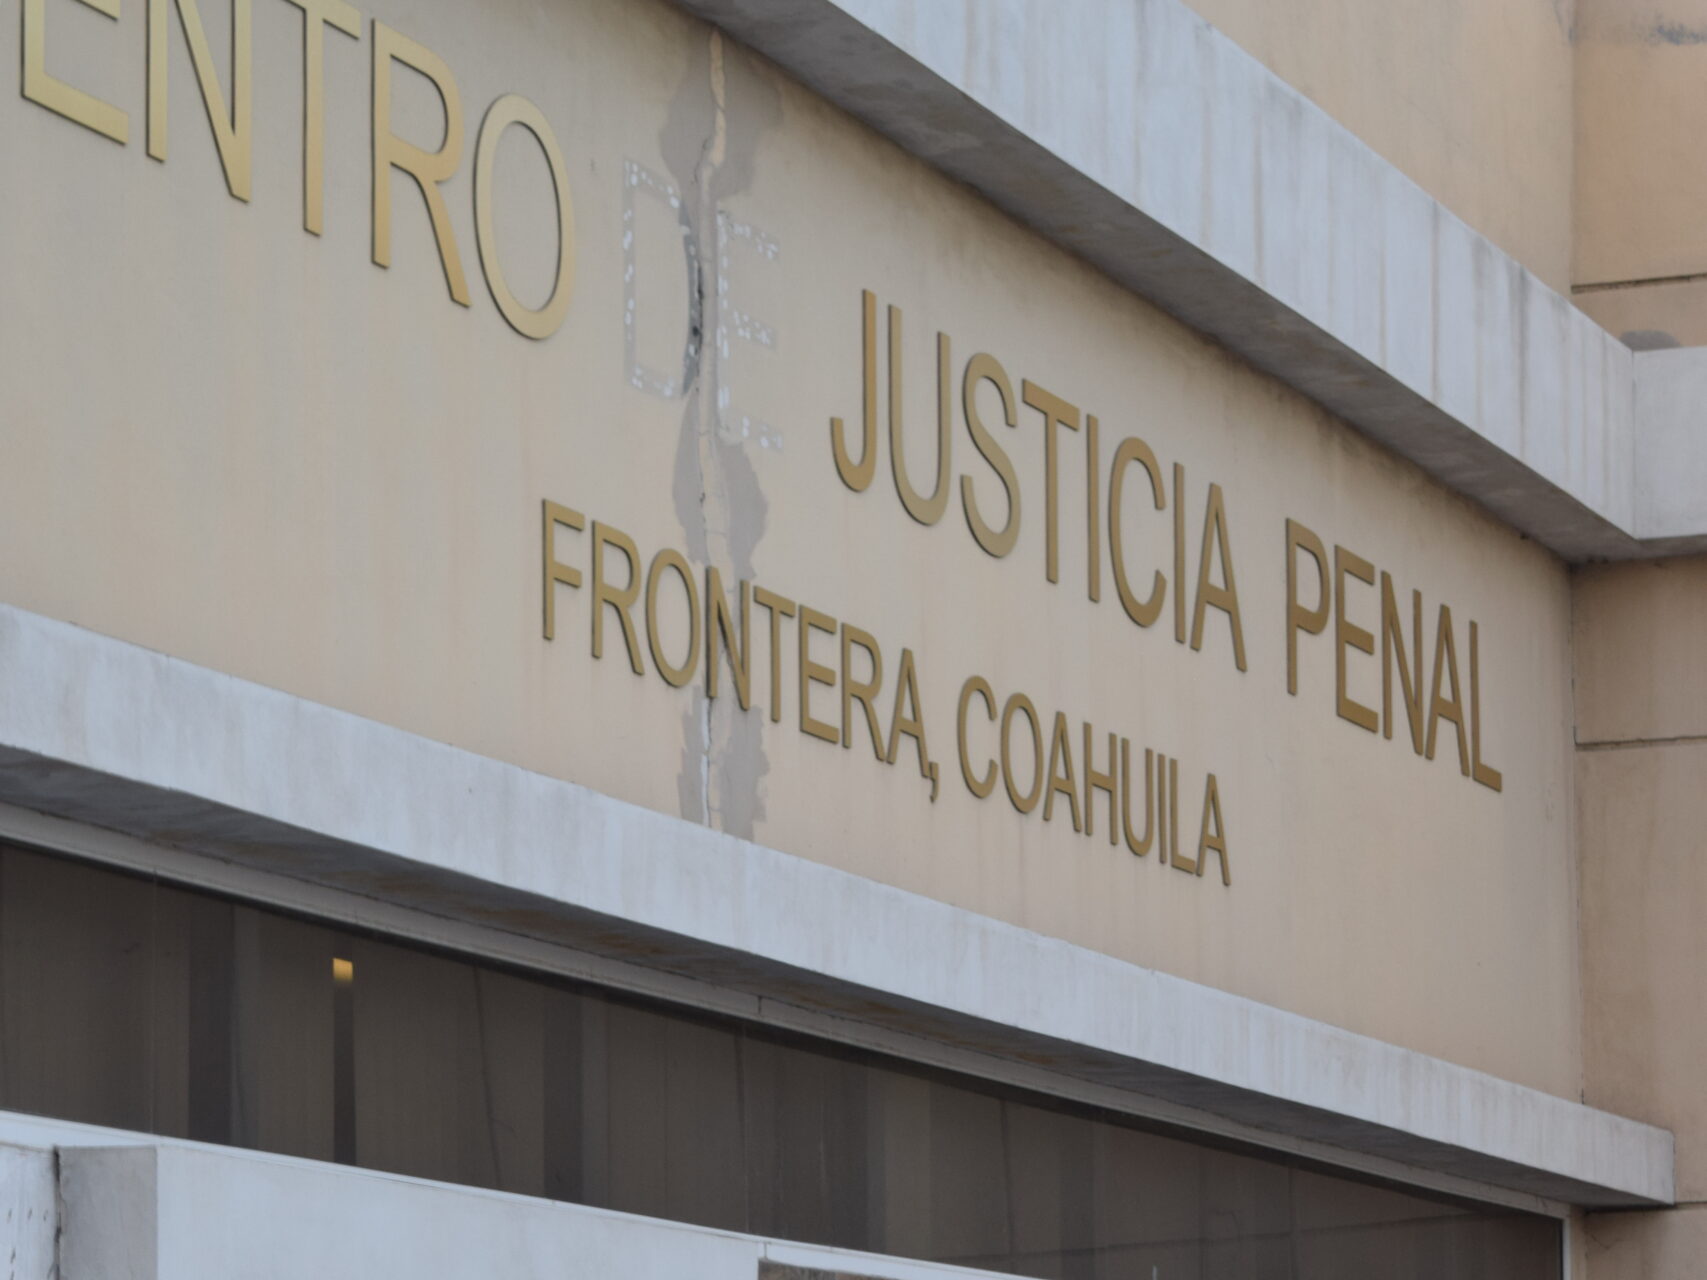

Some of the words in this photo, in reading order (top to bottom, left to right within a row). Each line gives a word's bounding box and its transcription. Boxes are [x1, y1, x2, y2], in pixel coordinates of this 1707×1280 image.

[542, 498, 940, 803] FRONTERA,
[956, 675, 1232, 887] COAHUILA
[622, 157, 785, 453] DE
[829, 288, 1248, 673] JUSTICIA
[1285, 517, 1502, 794] PENAL
